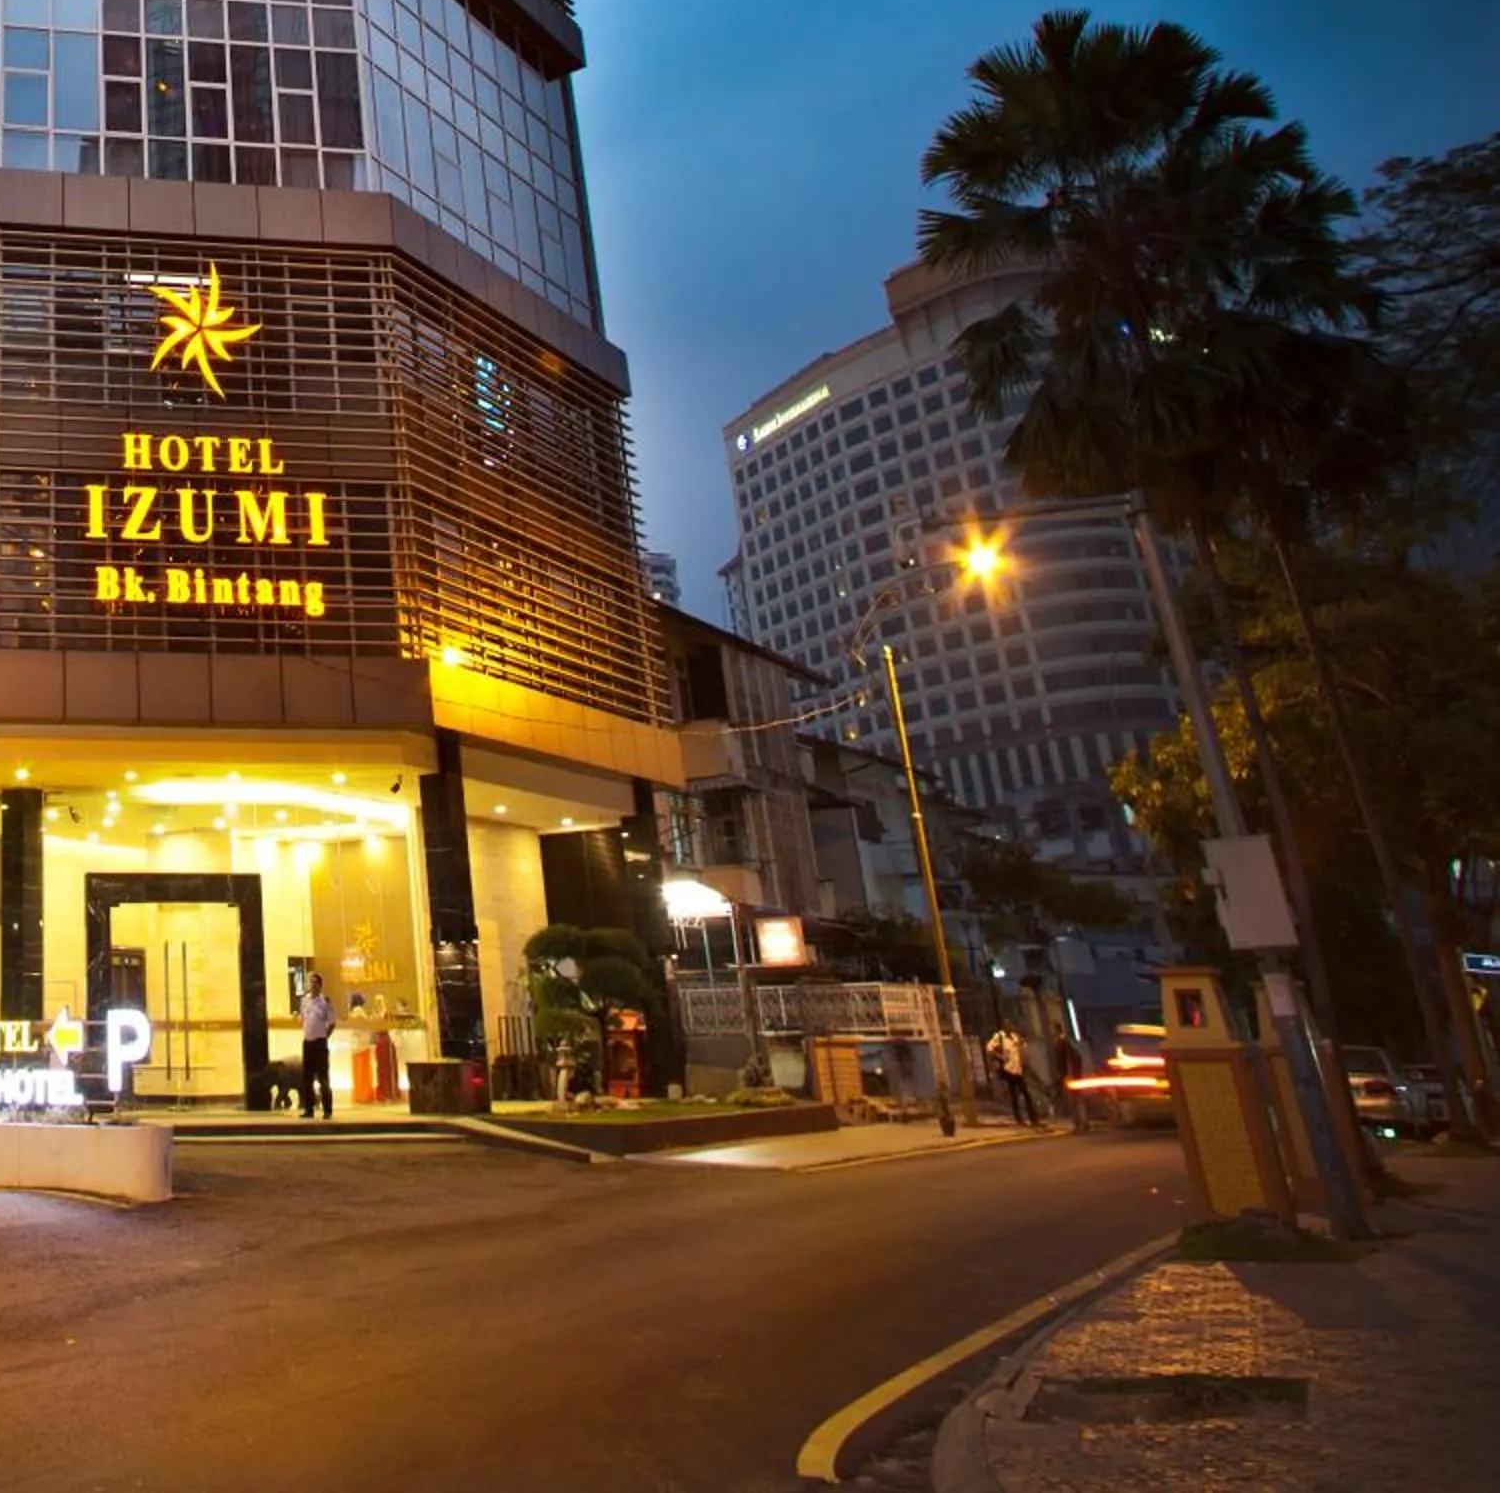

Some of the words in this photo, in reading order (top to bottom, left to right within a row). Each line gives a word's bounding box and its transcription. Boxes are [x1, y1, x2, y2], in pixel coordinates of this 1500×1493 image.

[121, 433, 285, 475] HOTEL
[85, 485, 330, 546] IZUMI
[95, 566, 156, 603] Bk.
[166, 568, 325, 617] Bintang
[106, 1008, 152, 1092] P
